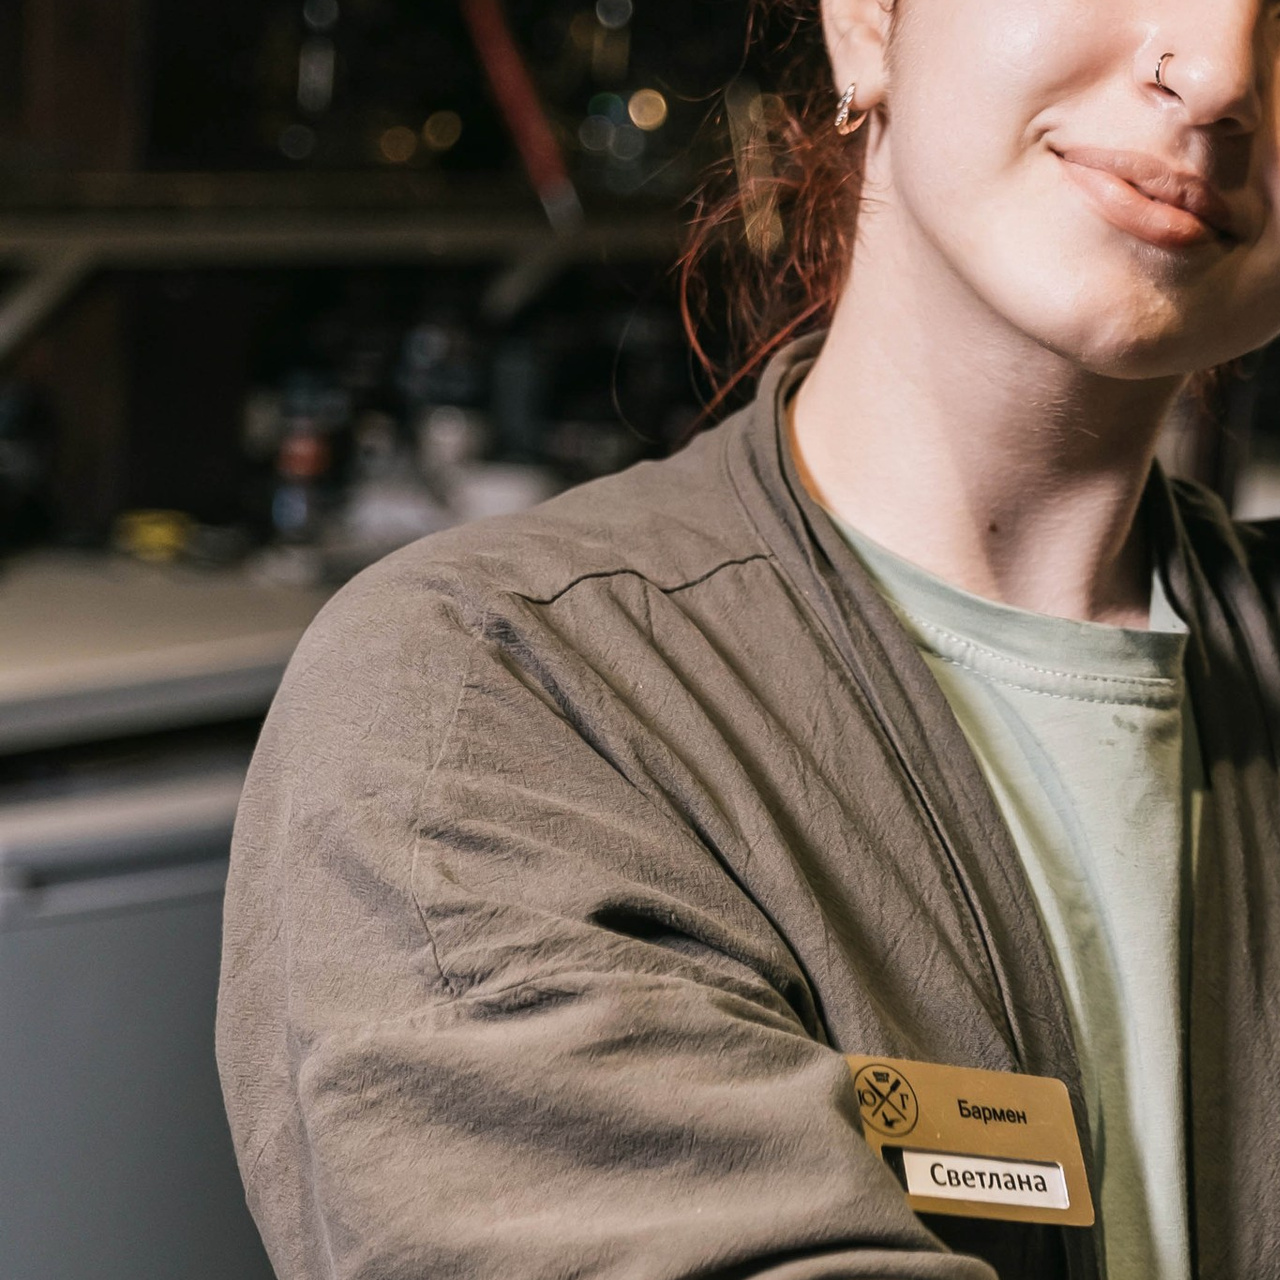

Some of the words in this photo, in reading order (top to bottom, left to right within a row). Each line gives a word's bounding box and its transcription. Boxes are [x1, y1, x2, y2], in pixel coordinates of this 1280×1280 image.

[857, 1088, 877, 1108] Ю
[957, 1099, 1027, 1125] Бармен
[930, 1162, 1048, 1193] Светлана
